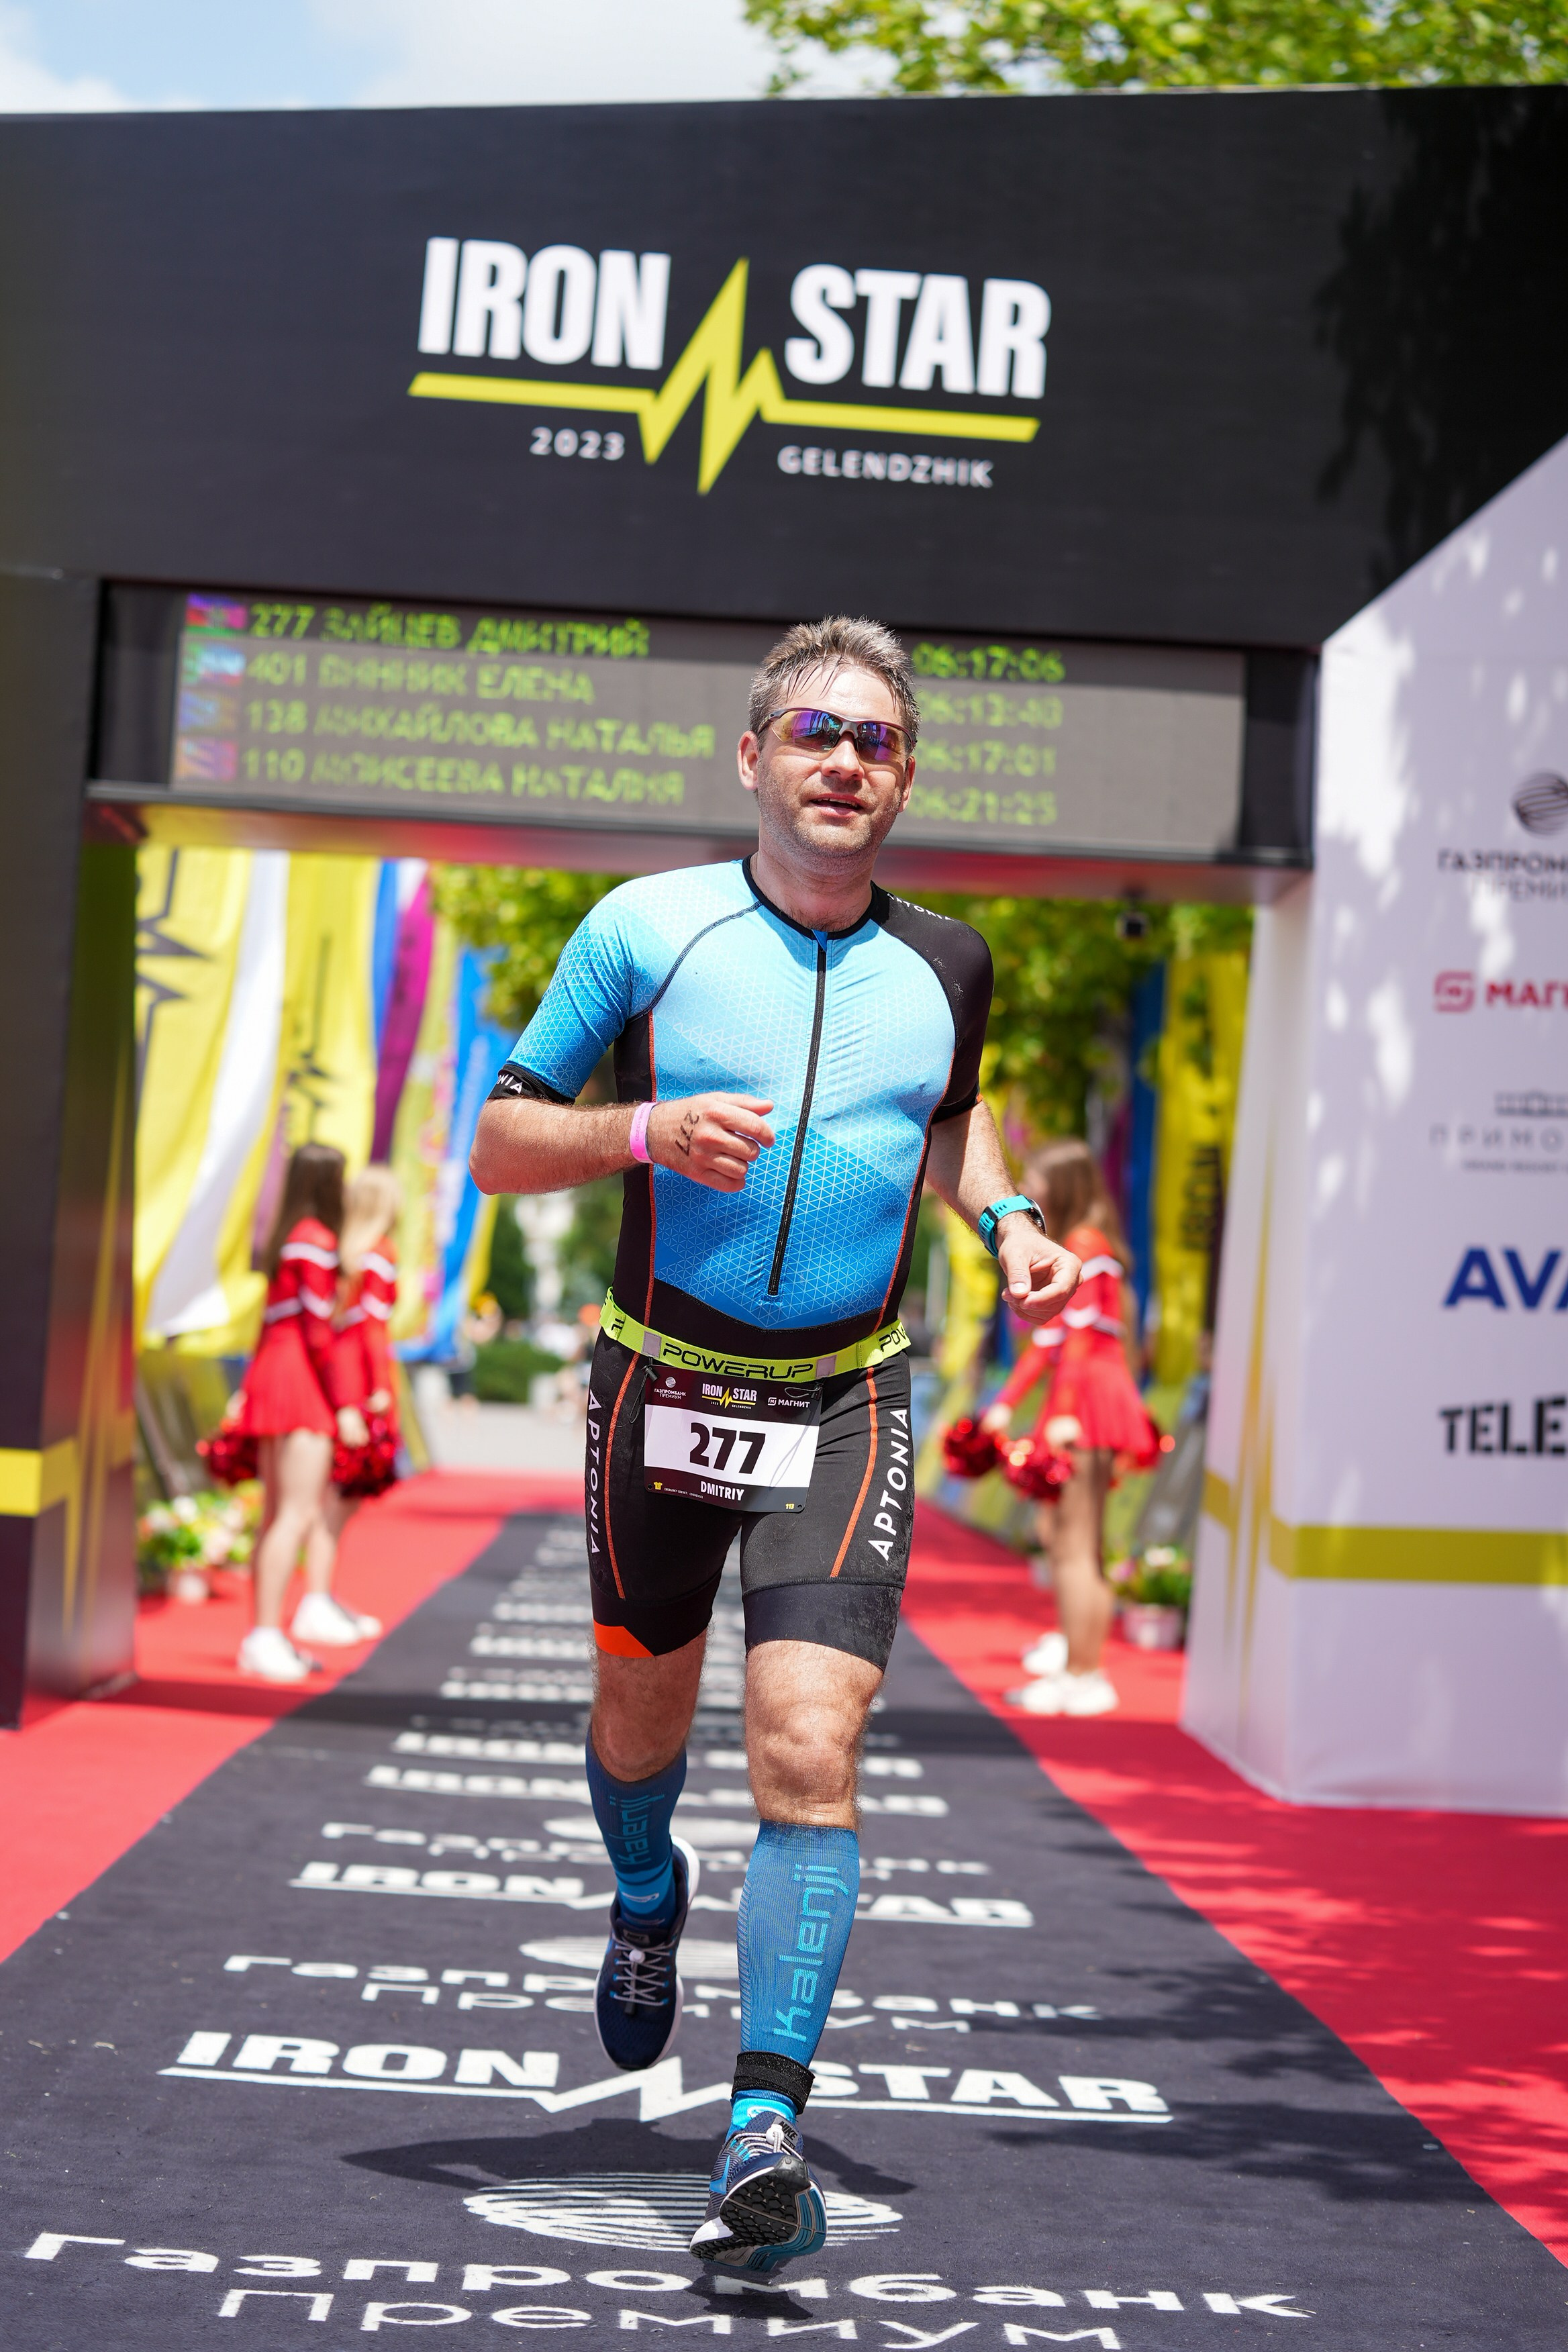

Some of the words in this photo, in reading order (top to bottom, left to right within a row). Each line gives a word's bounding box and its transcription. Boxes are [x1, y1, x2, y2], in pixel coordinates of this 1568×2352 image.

[418, 236, 671, 370] IRON
[784, 263, 1052, 398] STAR
[530, 426, 626, 460] 2023
[777, 446, 993, 488] GELENDZHIK
[250, 602, 315, 639] 277
[1485, 979, 1568, 1012] МАГ
[663, 1342, 813, 1379] POWERUP
[654, 1388, 687, 1397] ГАЗПРОМБАНК
[702, 1383, 723, 1397] IRON
[733, 1387, 757, 1402] STAR
[778, 1399, 810, 1408] МАГНИТ
[689, 1422, 766, 1475] 277
[588, 1389, 602, 1554] APTONIA
[700, 1481, 744, 1501] DMITRIY
[868, 1409, 909, 1562] APTONIA
[299, 1861, 583, 1898] IRON
[772, 1864, 849, 2041] kalenji
[177, 2031, 559, 2088] IRON
[807, 2061, 1169, 2112] STAR
[26, 2232, 1313, 2318] Газпромбанк
[218, 2289, 1121, 2351] Премиум
